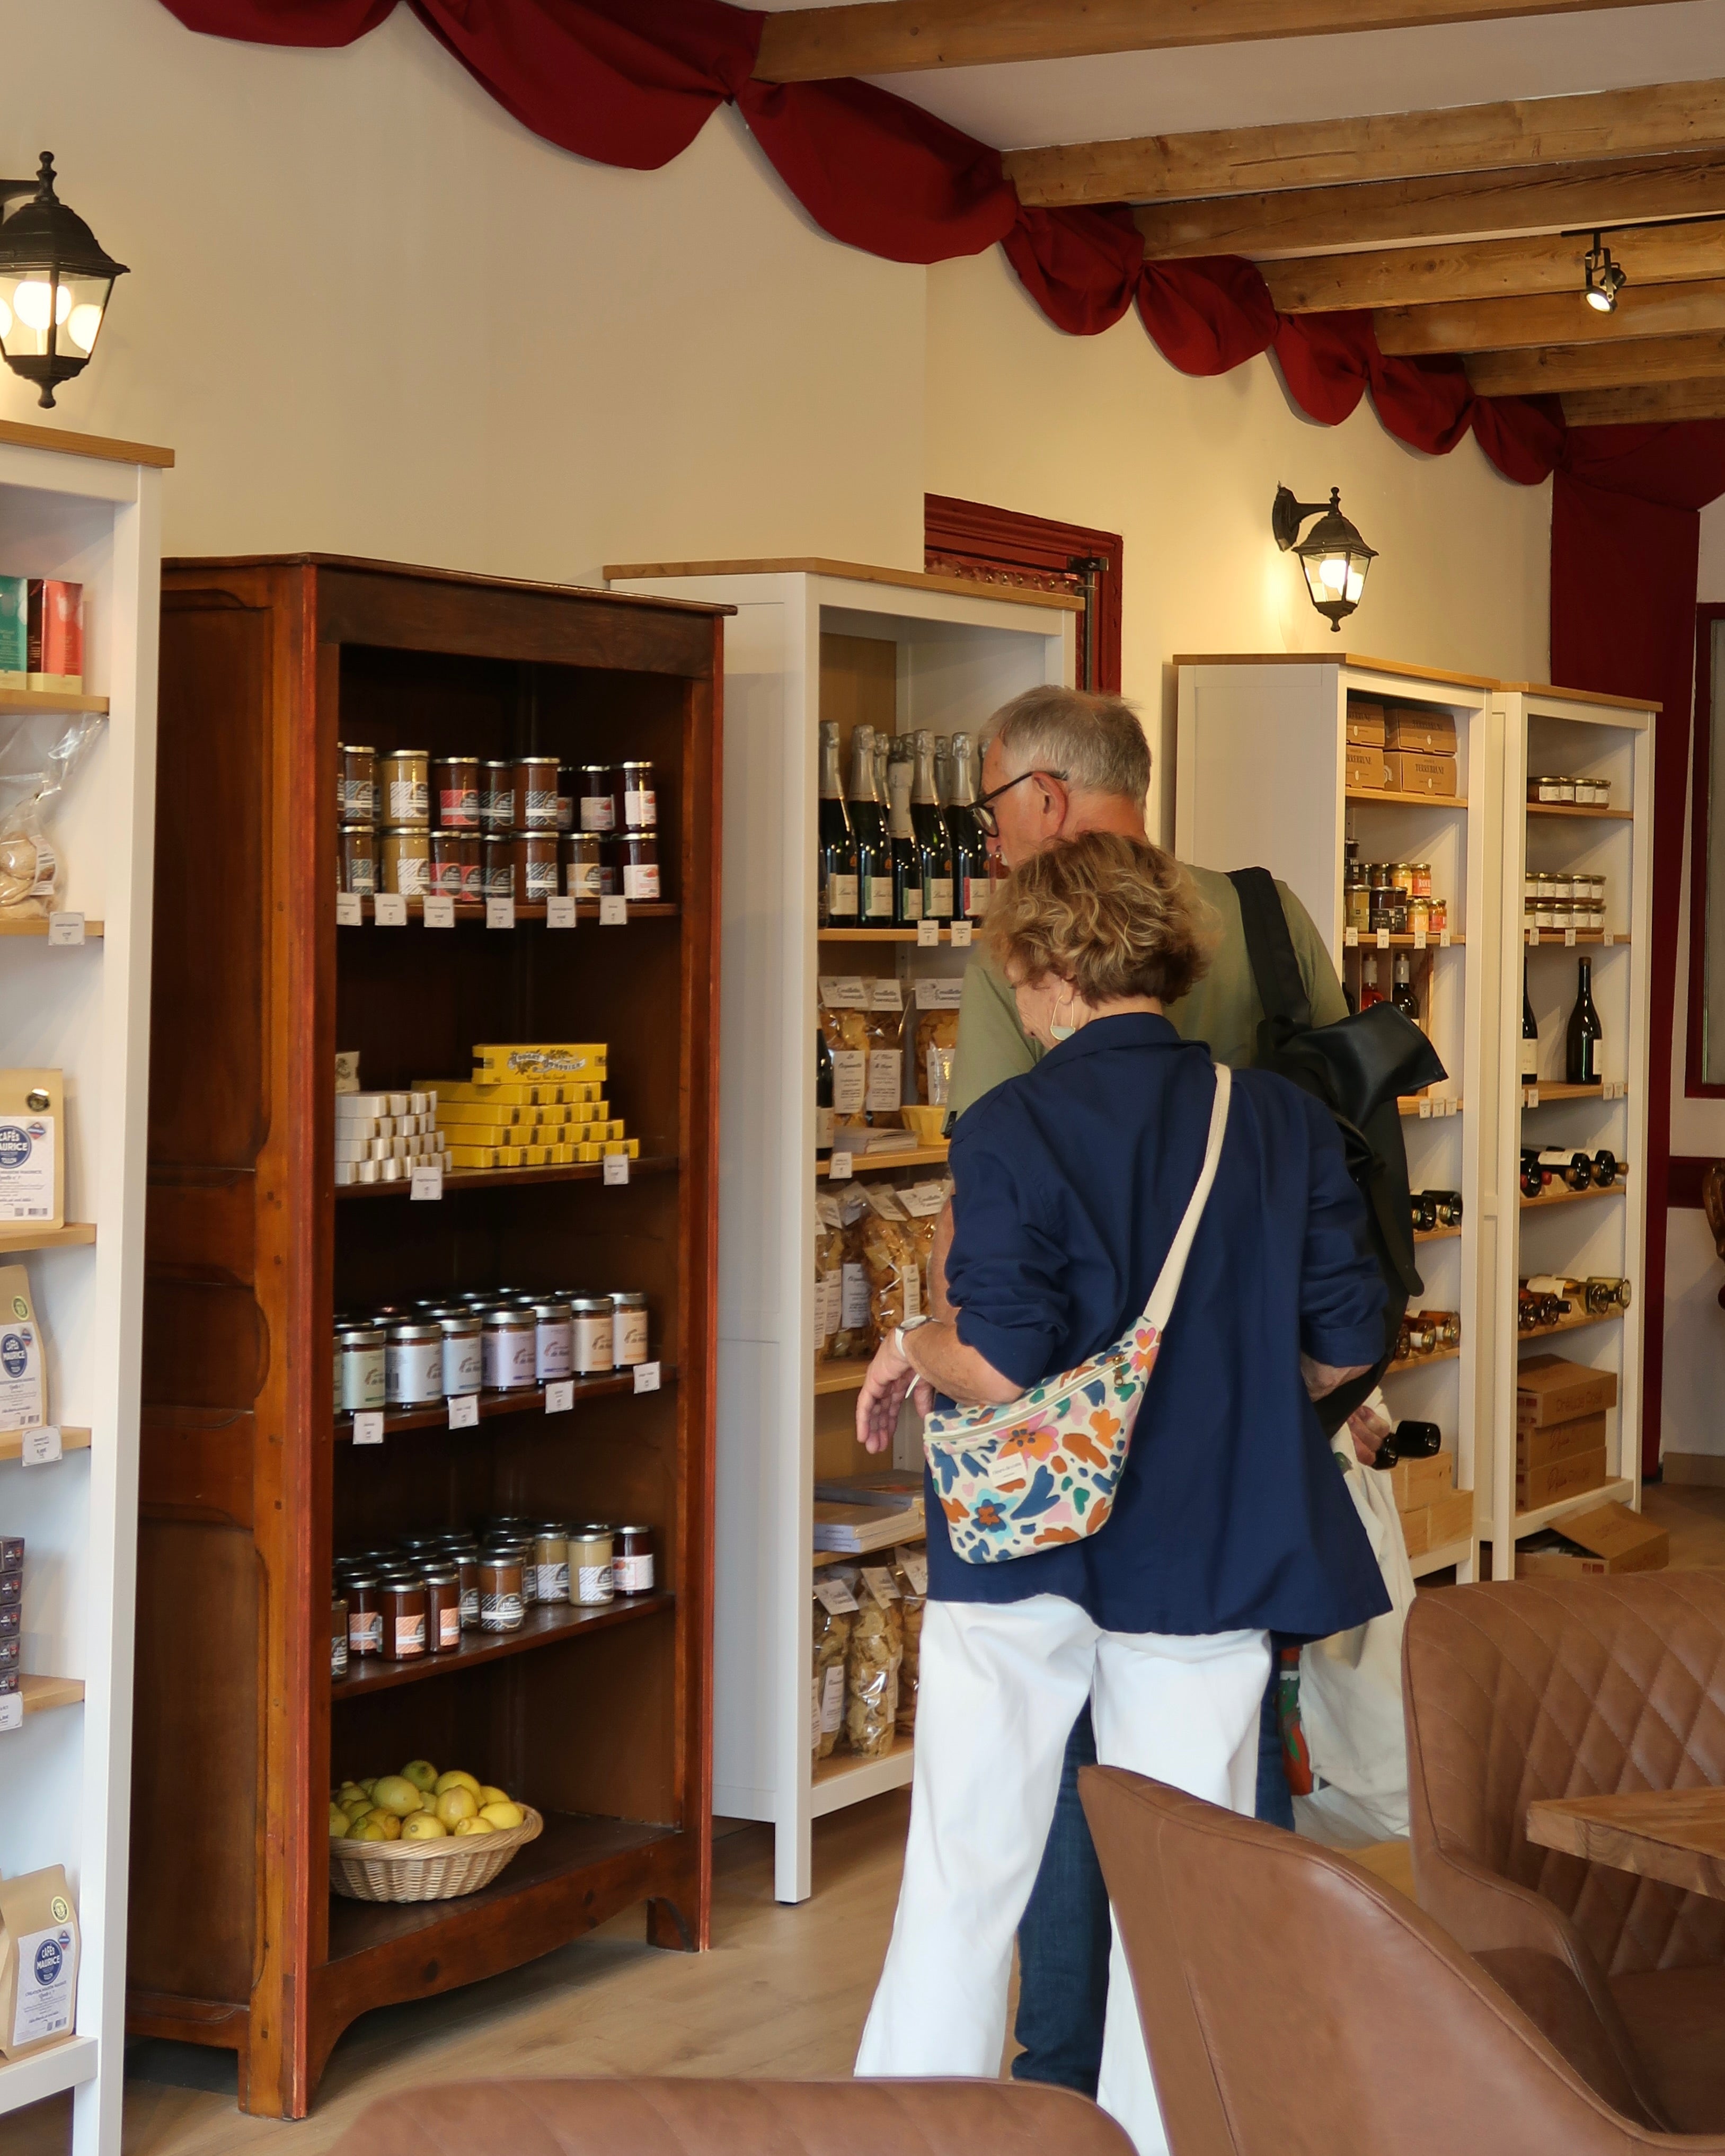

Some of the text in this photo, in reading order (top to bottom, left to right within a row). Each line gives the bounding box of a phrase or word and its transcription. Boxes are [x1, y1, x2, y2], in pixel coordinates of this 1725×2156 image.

[0, 1142, 28, 1151] AURICE
[41, 1944, 55, 1958] CAFÉS
[37, 1955, 60, 1970] MAURICE
